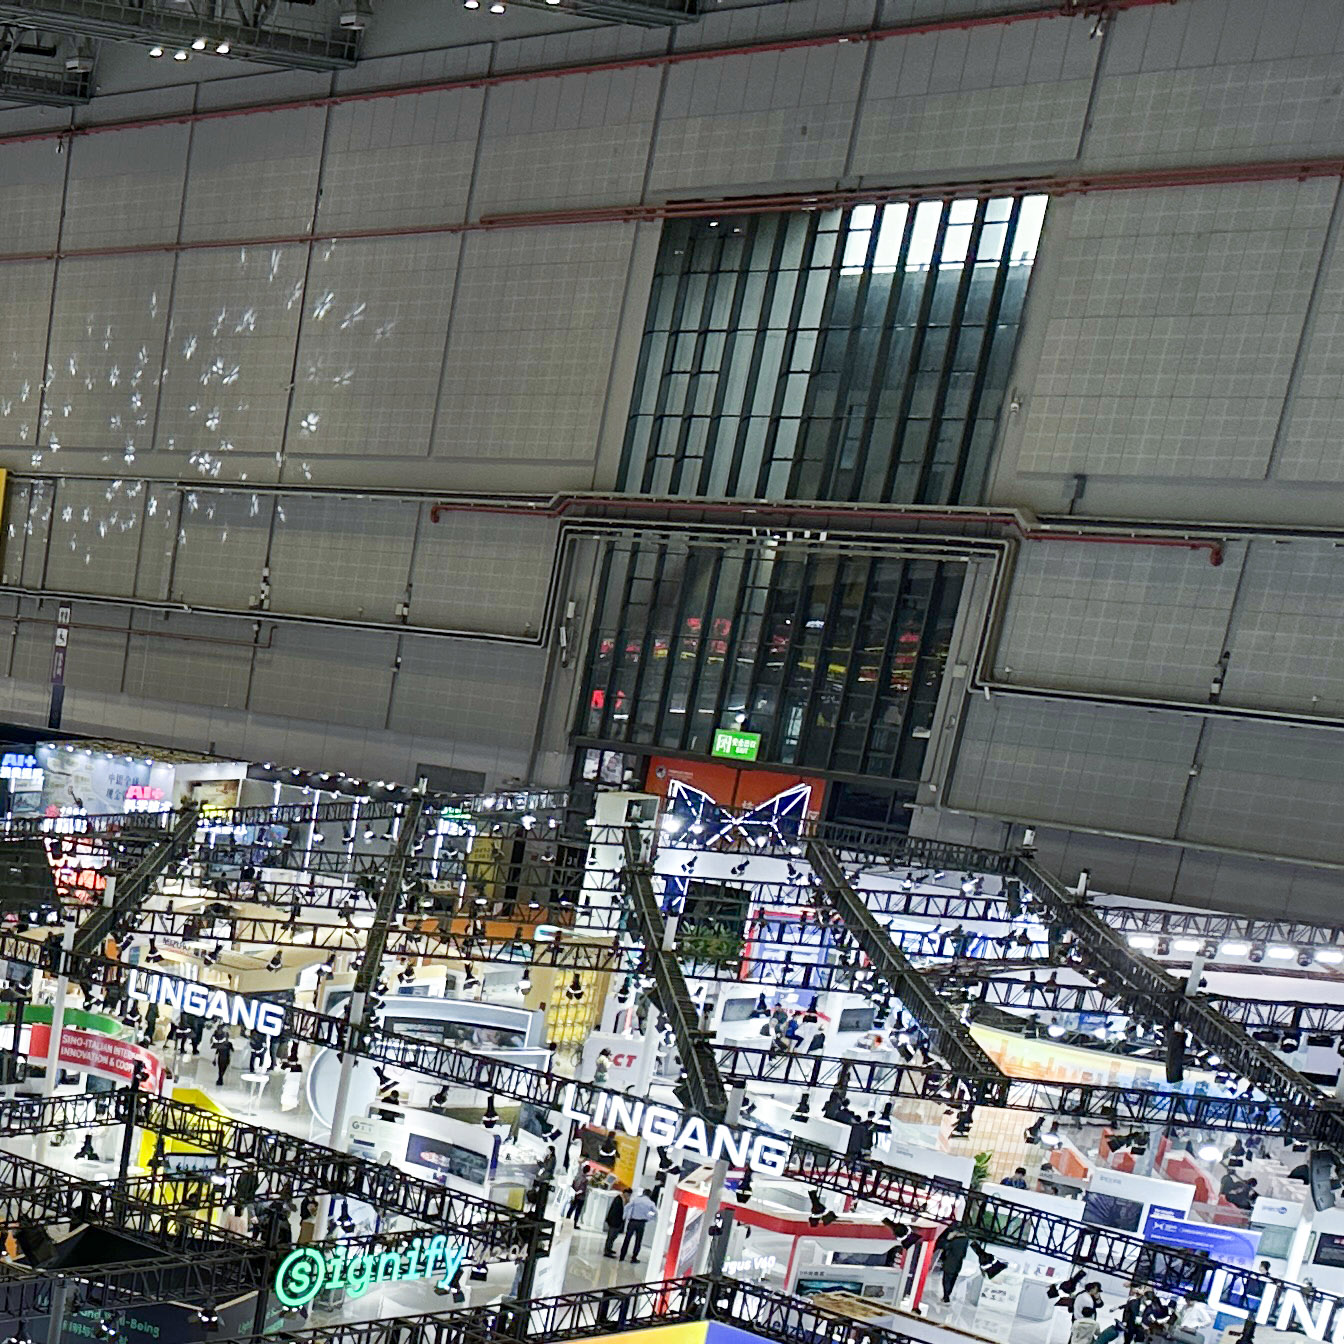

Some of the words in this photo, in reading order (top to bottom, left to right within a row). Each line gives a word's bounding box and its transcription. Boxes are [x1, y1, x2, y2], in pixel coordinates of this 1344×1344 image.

[127, 968, 286, 1038] LINGANG
[561, 1080, 792, 1177] LINGANG
[274, 1234, 467, 1308] Signify
